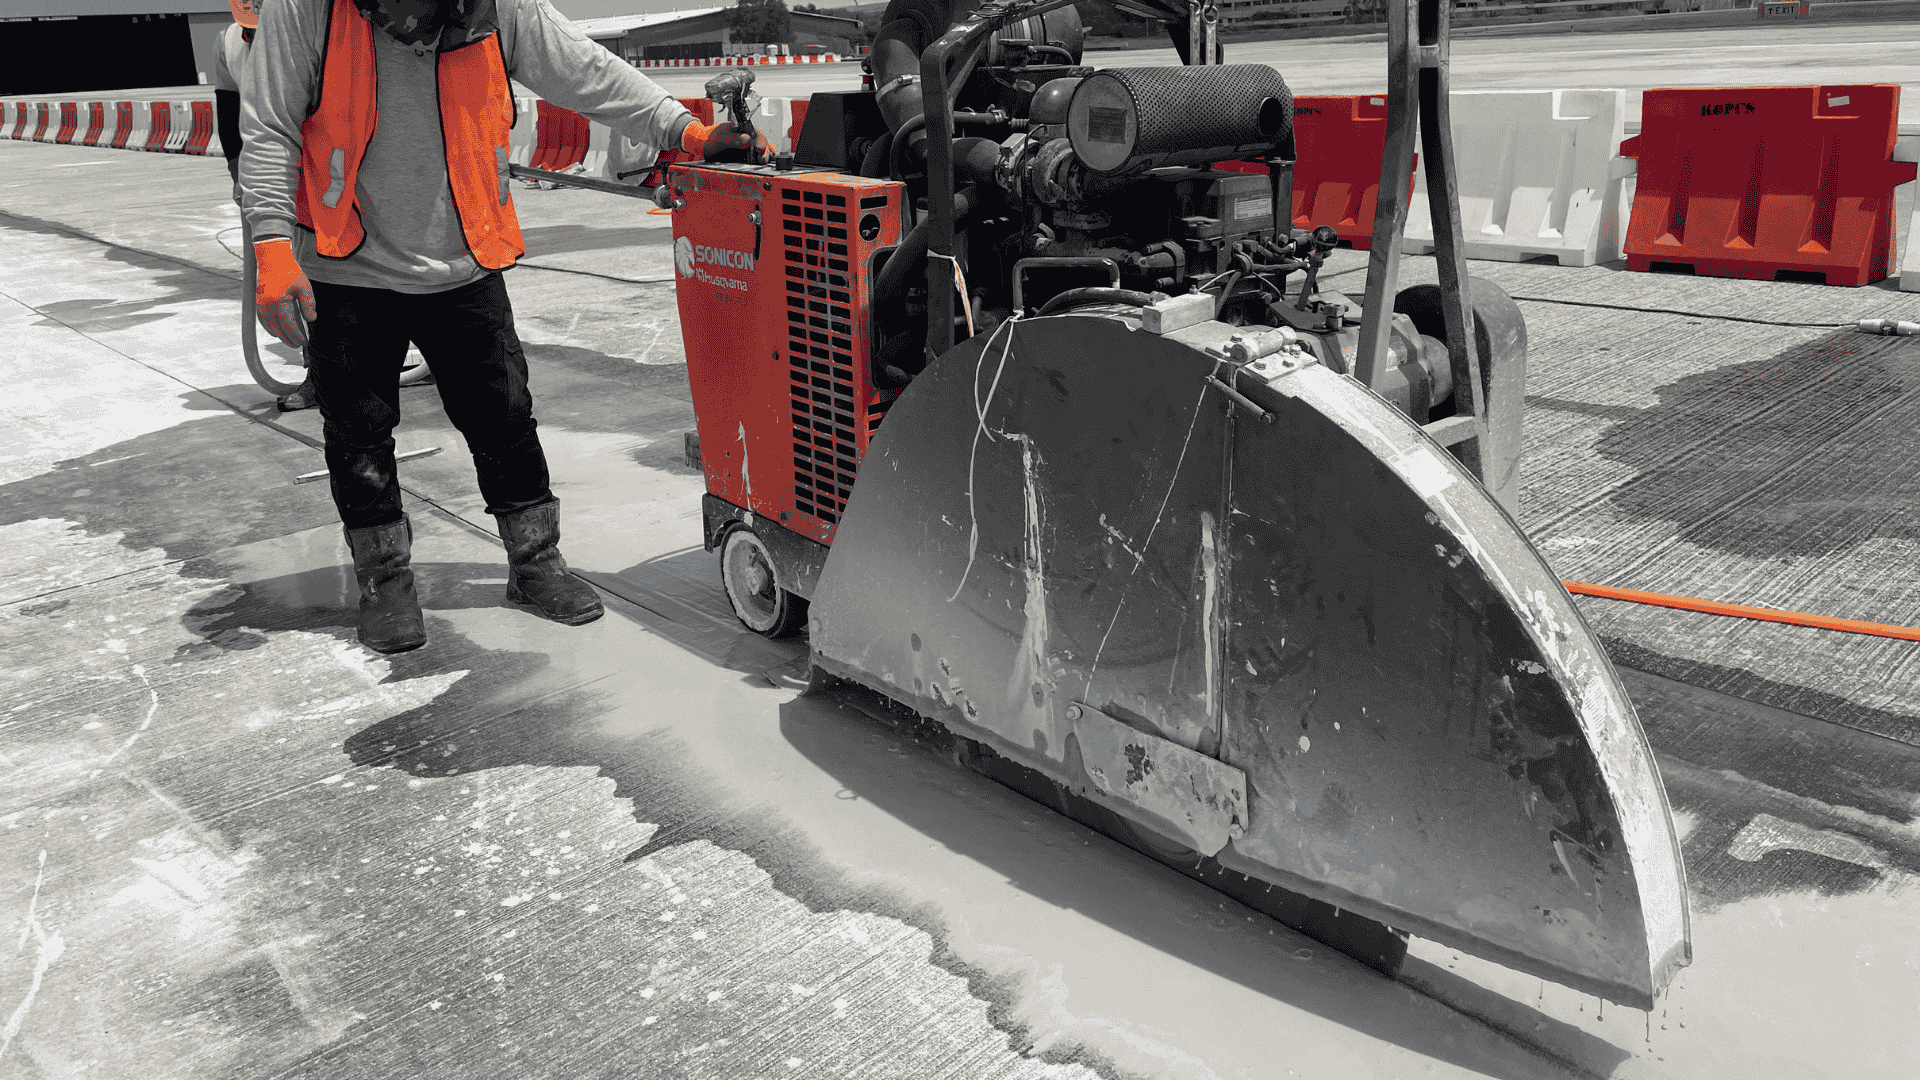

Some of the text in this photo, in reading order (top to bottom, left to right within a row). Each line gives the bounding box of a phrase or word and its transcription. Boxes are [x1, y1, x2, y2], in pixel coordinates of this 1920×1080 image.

[1775, 6, 1795, 15] EXIT
[695, 244, 755, 272] SONICON
[702, 271, 748, 292] Husqvarna
